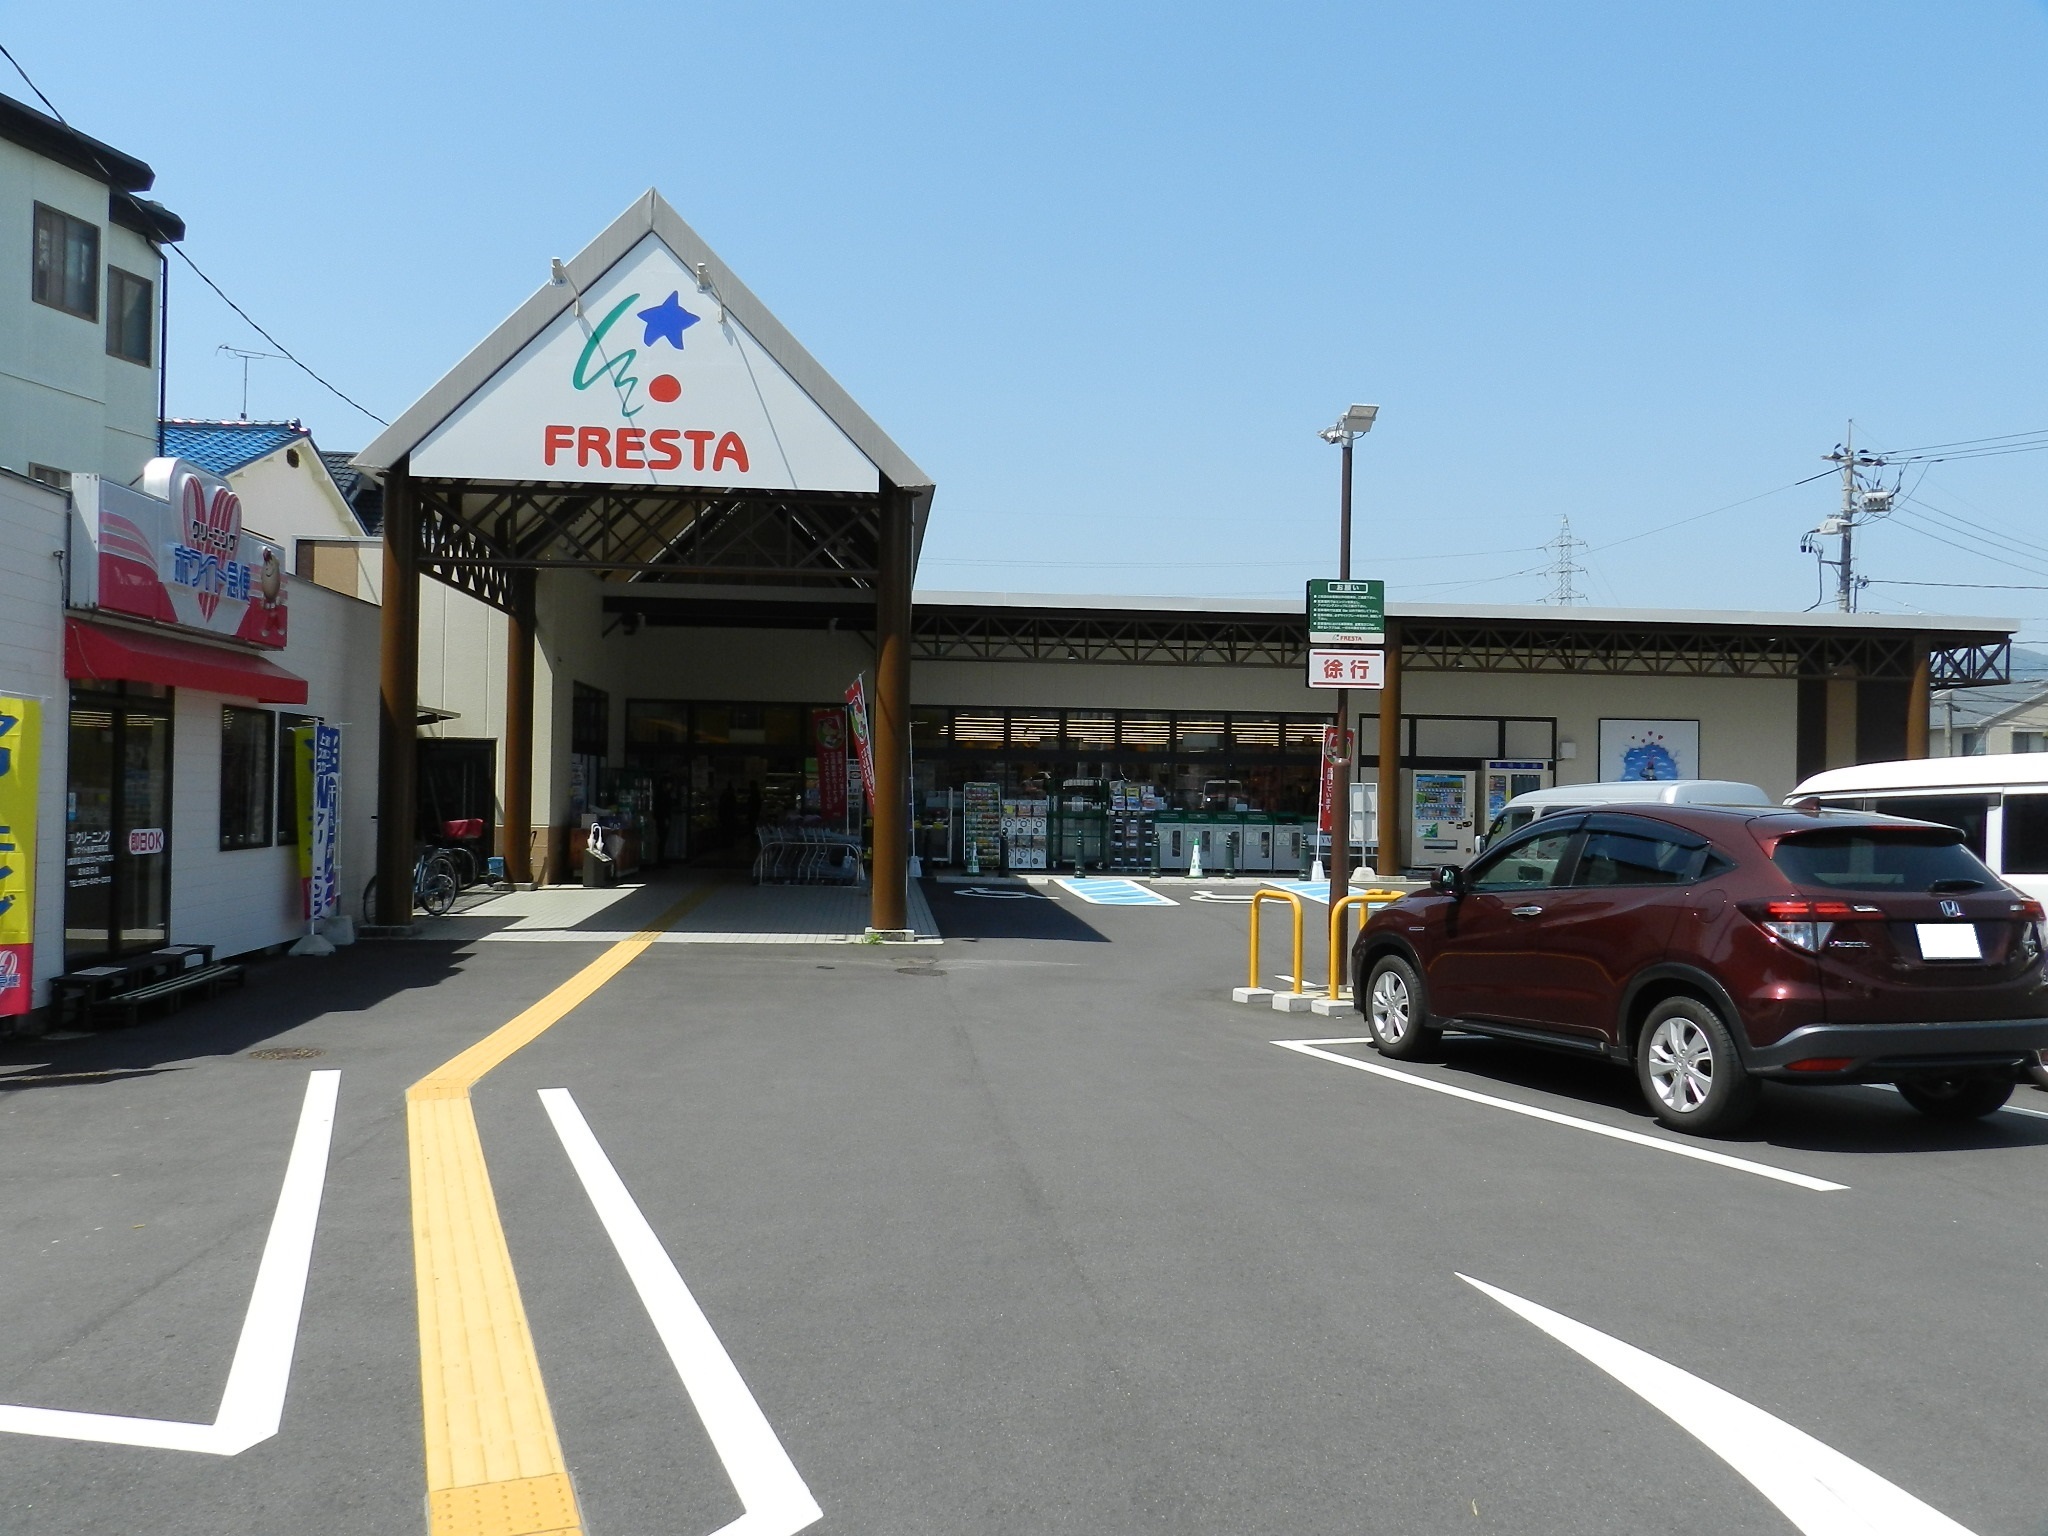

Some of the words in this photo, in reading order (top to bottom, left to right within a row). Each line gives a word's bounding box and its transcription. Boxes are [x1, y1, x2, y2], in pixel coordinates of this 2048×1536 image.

[544, 424, 750, 474] FRESTA
[192, 519, 238, 552] クリーニング
[174, 544, 251, 602] ホワイト急便
[1323, 659, 1370, 680] 徐行
[75, 830, 111, 845] クリーニング
[131, 832, 162, 851] 即日OK
